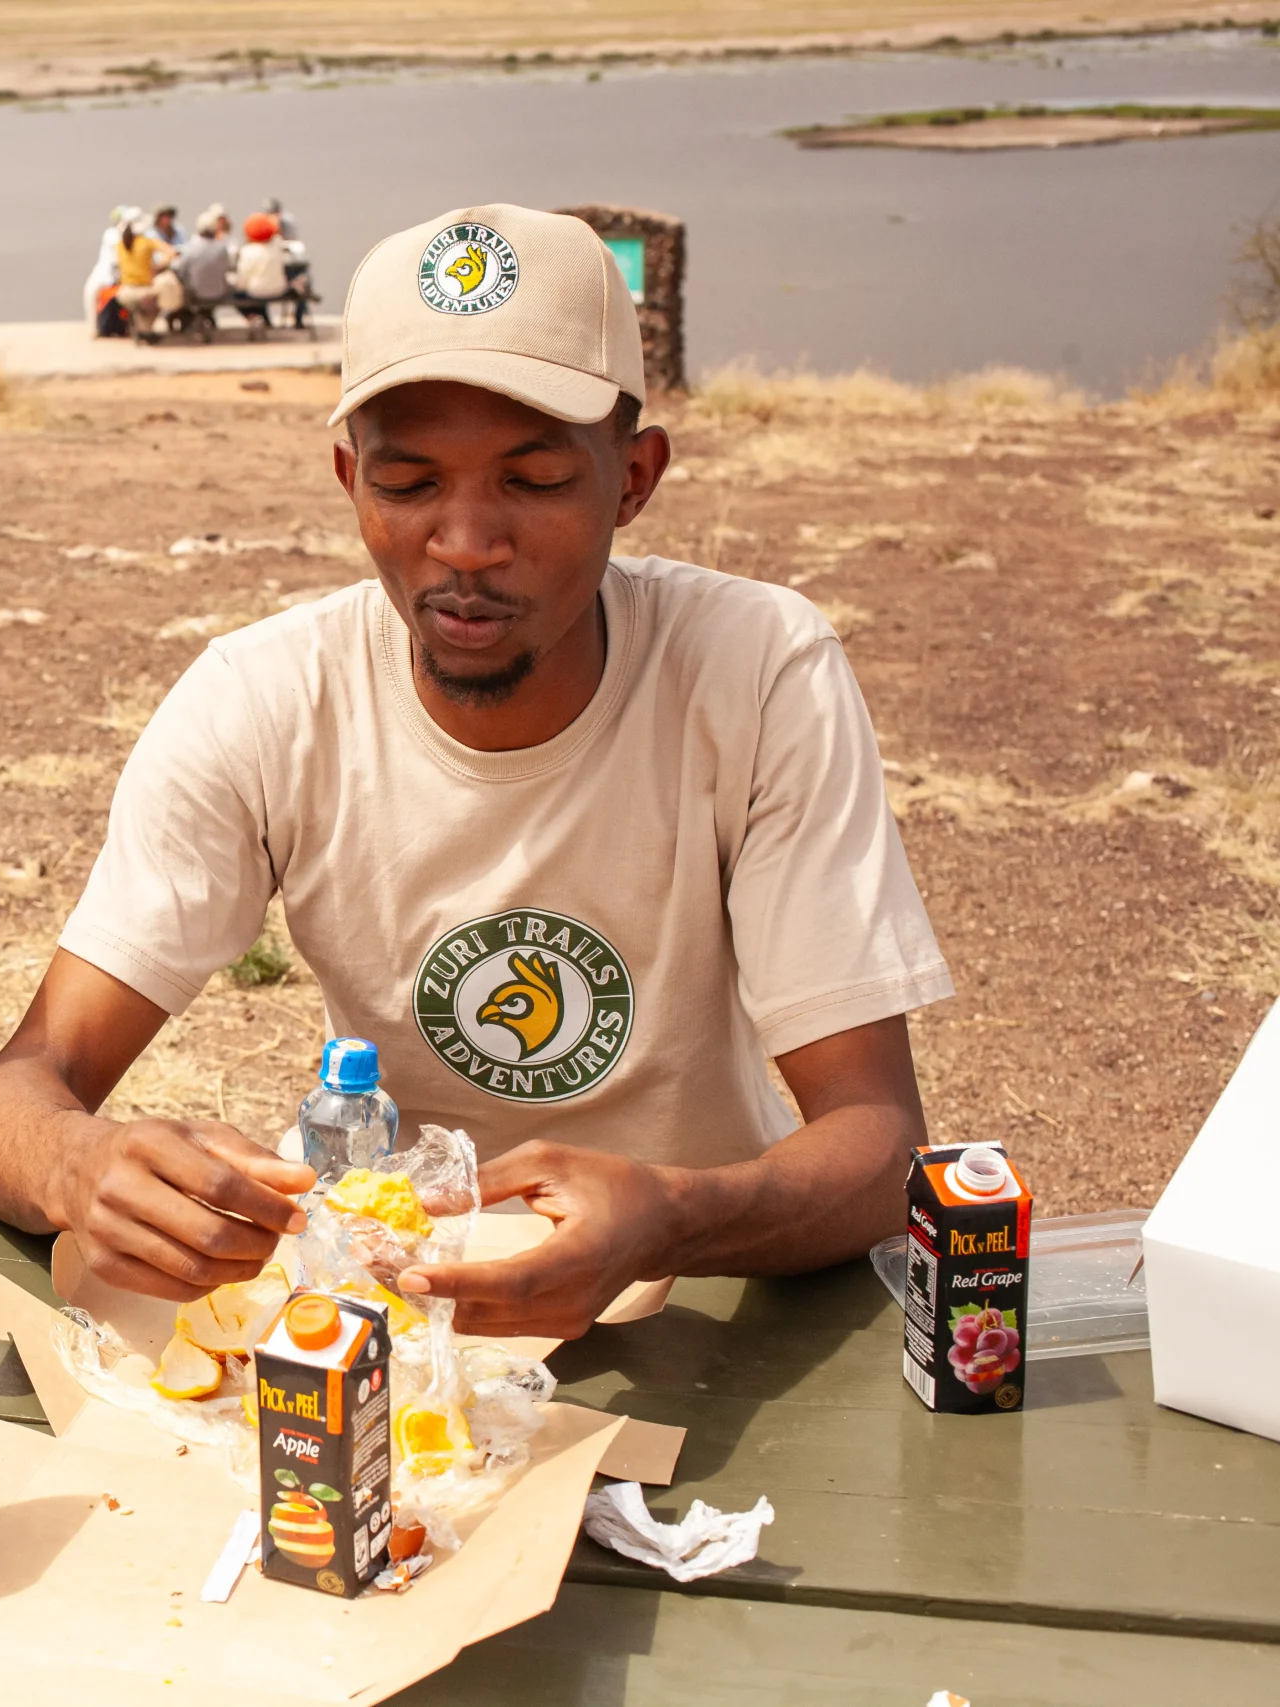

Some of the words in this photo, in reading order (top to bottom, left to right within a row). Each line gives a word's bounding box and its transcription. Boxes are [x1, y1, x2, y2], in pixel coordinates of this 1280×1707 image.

[423, 229, 459, 265] ZURI
[465, 226, 515, 269] TRAILS
[420, 276, 515, 312] ADVENTURES
[423, 929, 489, 1000] ZURI
[498, 916, 620, 986] TRAILS
[427, 1009, 624, 1094] ADVENTURES
[949, 1229, 977, 1256] PICK
[986, 1225, 1011, 1253] PEEL
[951, 1272, 979, 1288] Red
[981, 1271, 1023, 1288] Grape
[259, 1378, 287, 1413] PICK
[296, 1390, 322, 1422] PEEL
[272, 1432, 320, 1458] Apple
